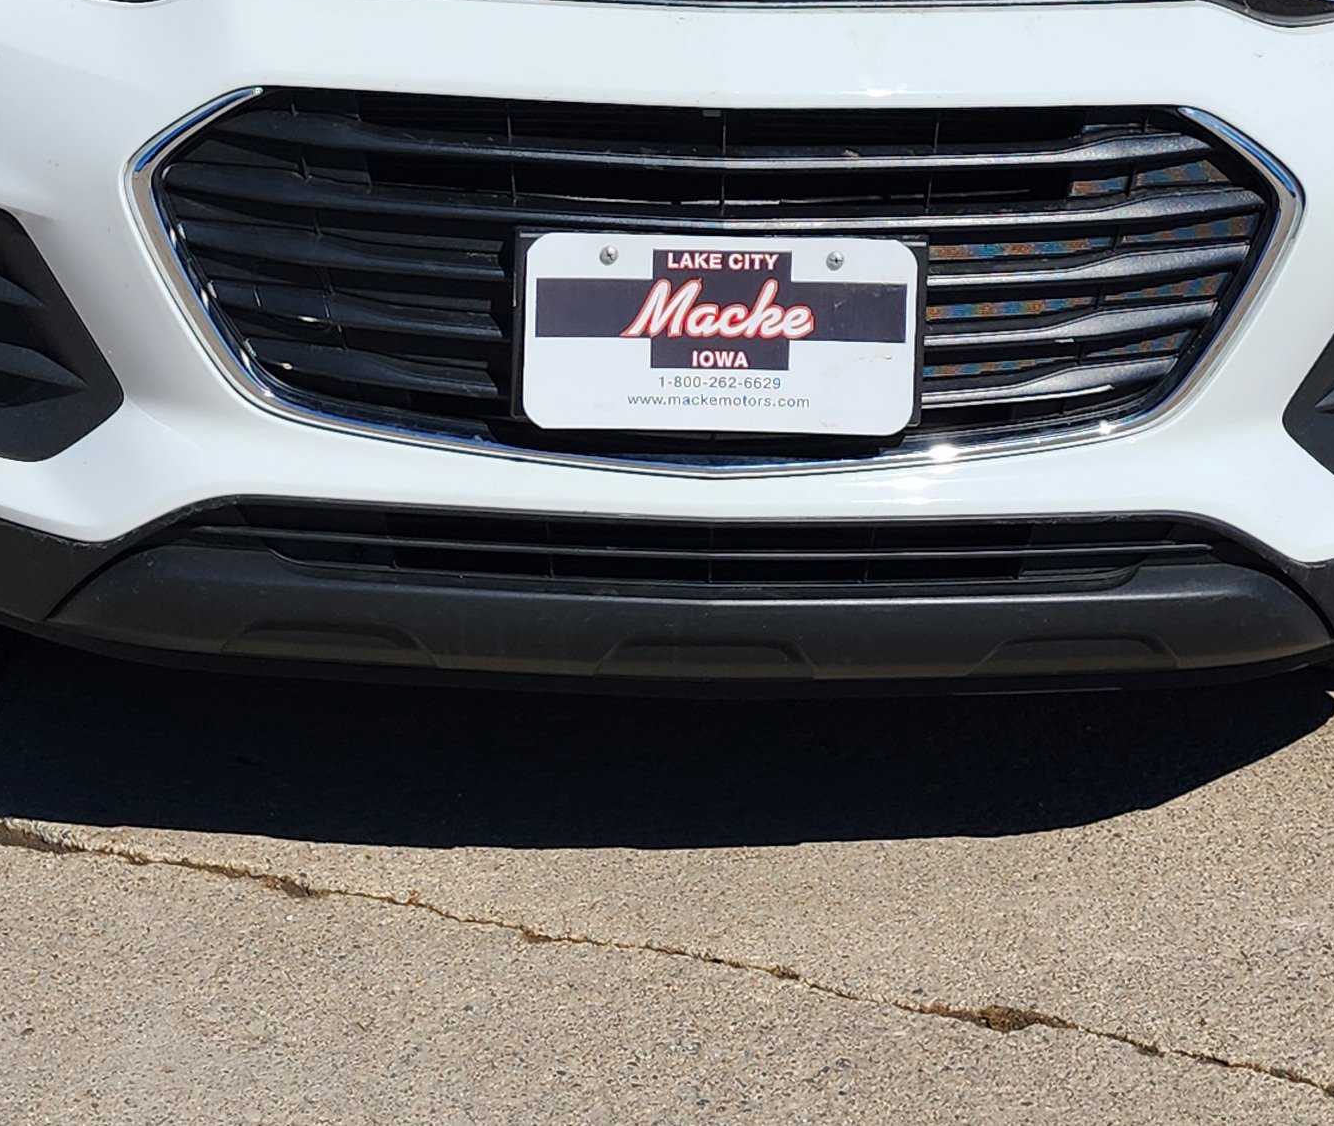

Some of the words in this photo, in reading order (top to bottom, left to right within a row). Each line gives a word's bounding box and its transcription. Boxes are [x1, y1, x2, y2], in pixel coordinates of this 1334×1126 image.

[667, 252, 723, 270] LAKE
[728, 253, 780, 271] CITY
[619, 277, 815, 339] Macke
[691, 350, 749, 368] IOWA
[658, 375, 782, 390] 1-800-262-6629
[627, 393, 811, 409] www.mackemotors.com
